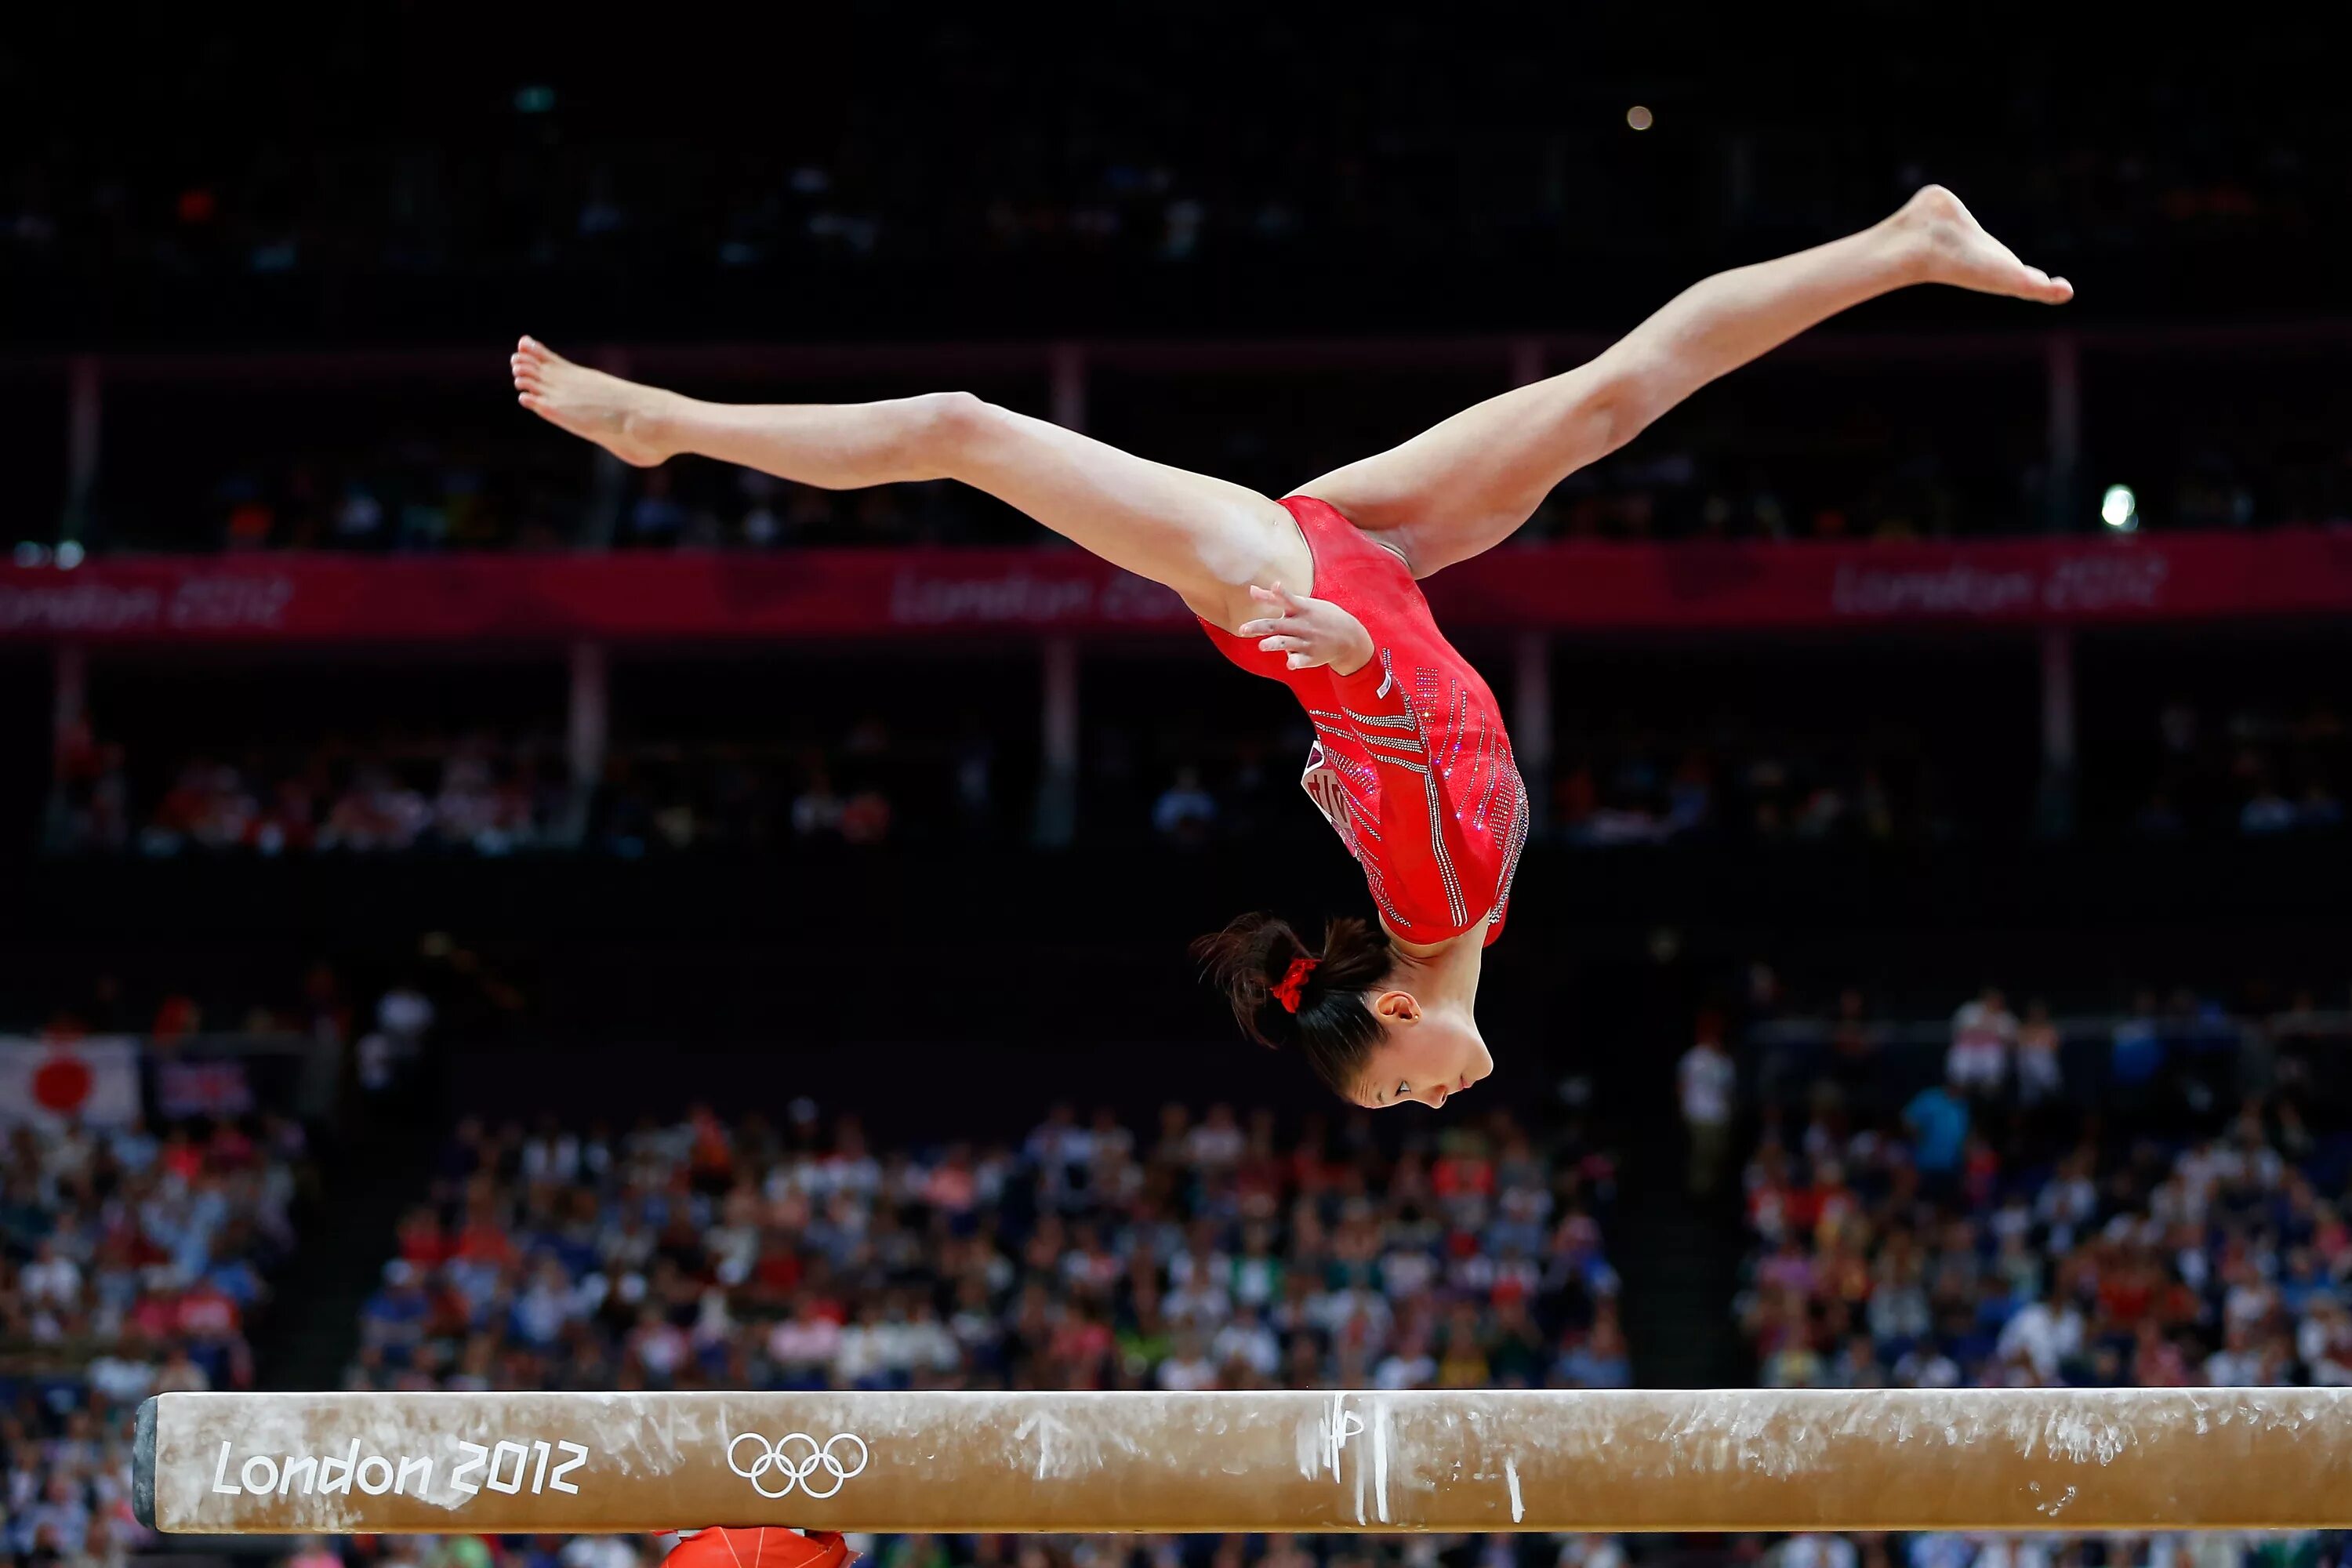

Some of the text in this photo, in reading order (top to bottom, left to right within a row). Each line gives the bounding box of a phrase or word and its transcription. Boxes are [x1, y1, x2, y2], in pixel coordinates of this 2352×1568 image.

[0, 580, 158, 629] ondon
[891, 564, 1094, 622] London
[1832, 554, 2169, 615] London 2012
[212, 1437, 589, 1495] London 2012
